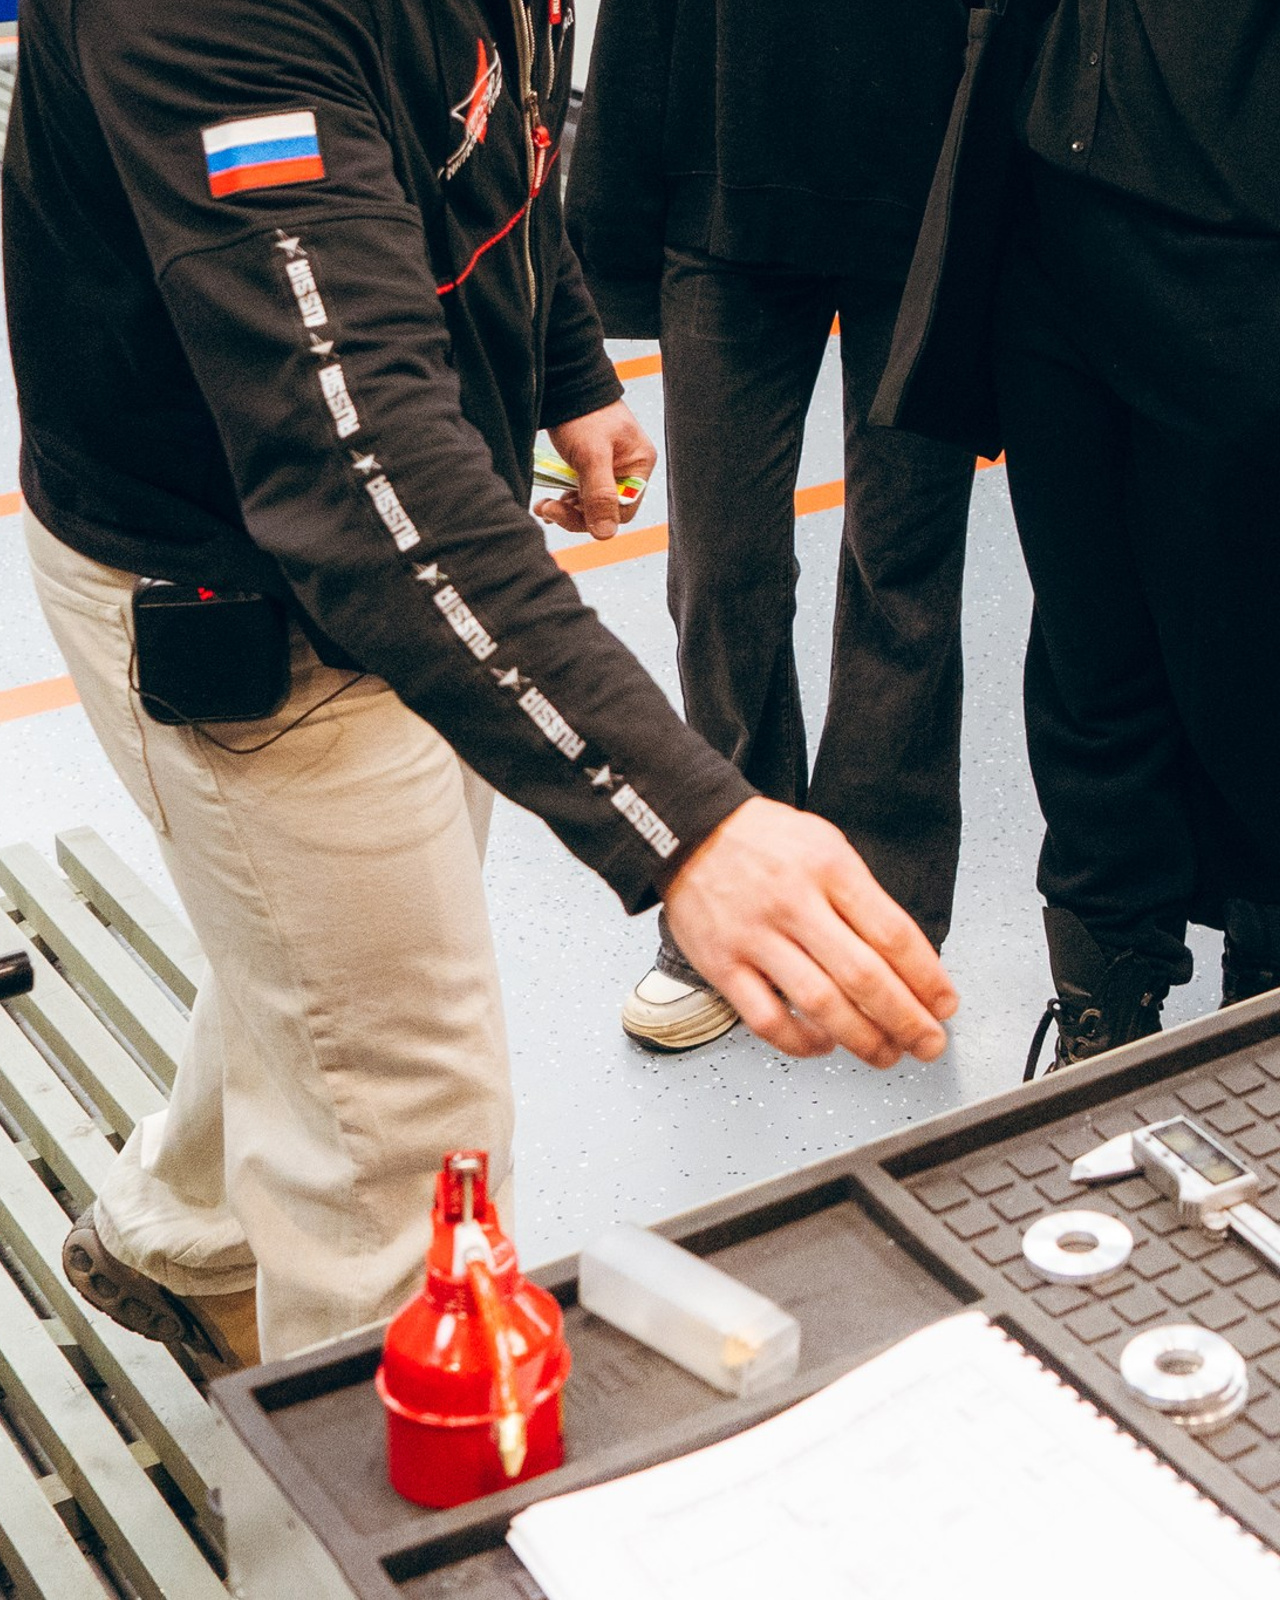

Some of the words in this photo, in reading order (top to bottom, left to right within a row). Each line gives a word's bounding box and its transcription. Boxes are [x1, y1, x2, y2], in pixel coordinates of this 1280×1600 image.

[318, 363, 361, 439] RUSSIA
[433, 584, 498, 661] RUSSIA
[518, 687, 587, 761] RUSSIA
[611, 783, 680, 859] RUSSIA
